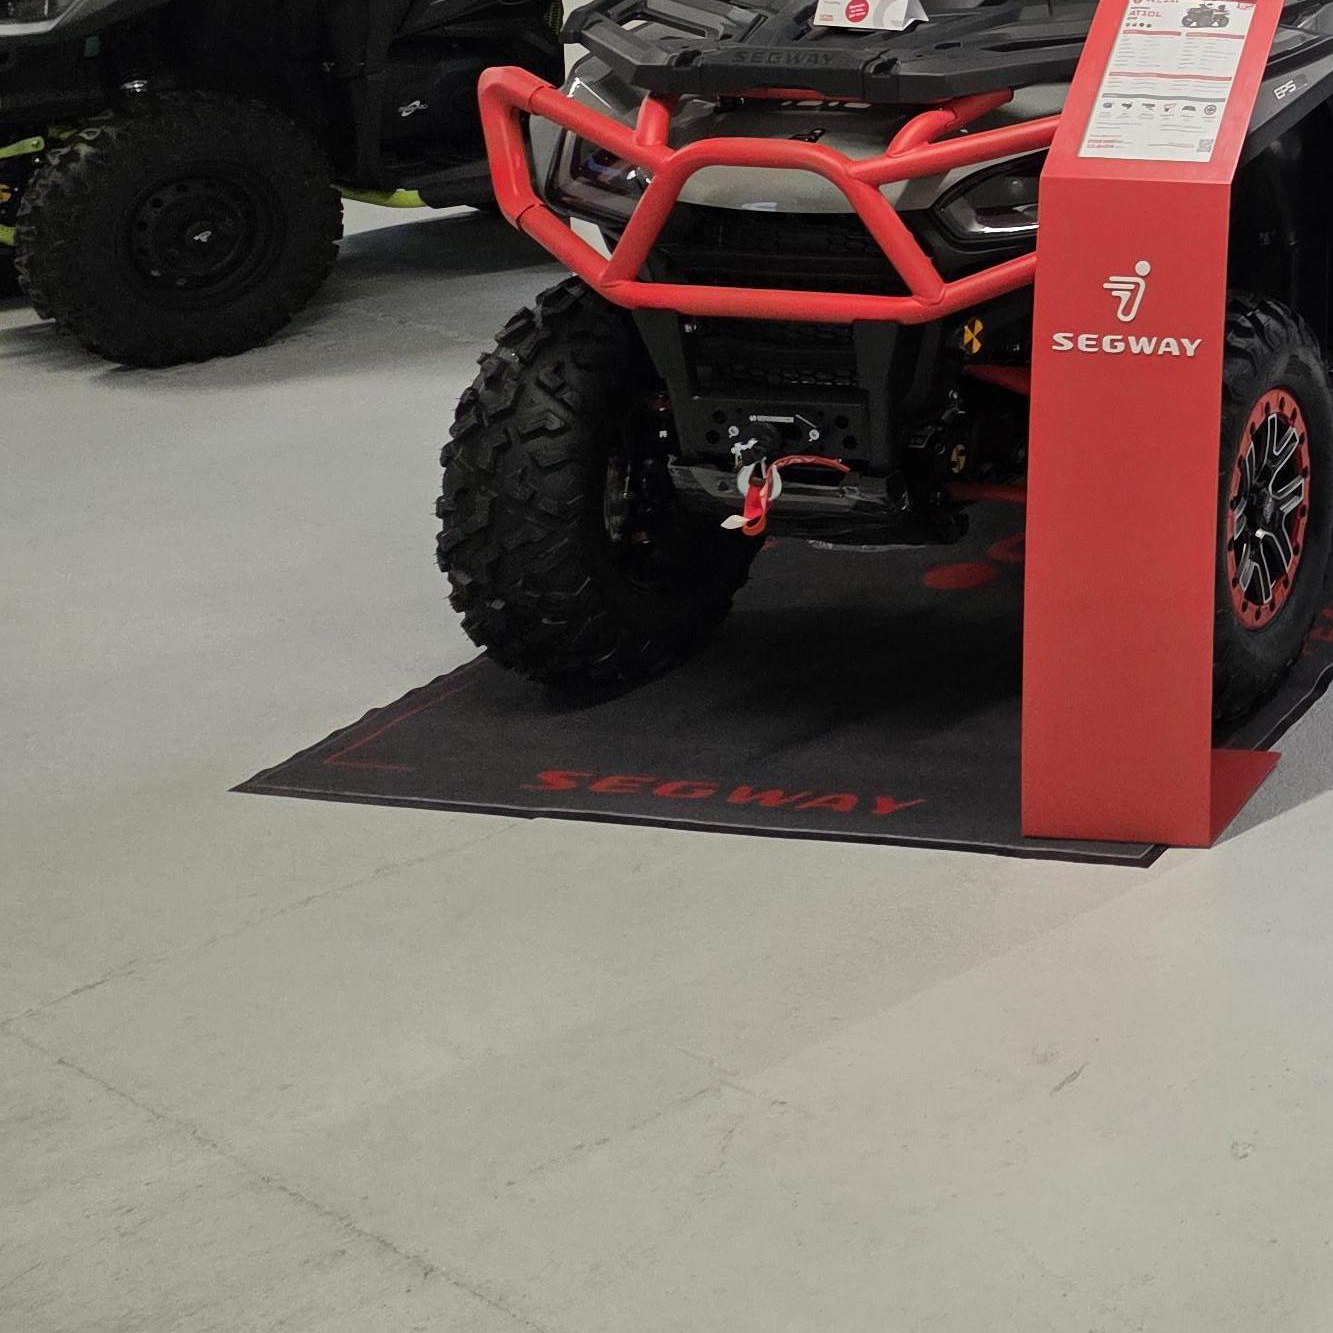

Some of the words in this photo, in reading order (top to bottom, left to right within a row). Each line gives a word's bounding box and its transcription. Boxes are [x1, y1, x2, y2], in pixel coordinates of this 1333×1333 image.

[733, 50, 834, 66] SEGWAY
[1274, 80, 1296, 100] EPS
[1051, 331, 1203, 358] SEGWAY
[522, 768, 926, 817] SEGWAY
